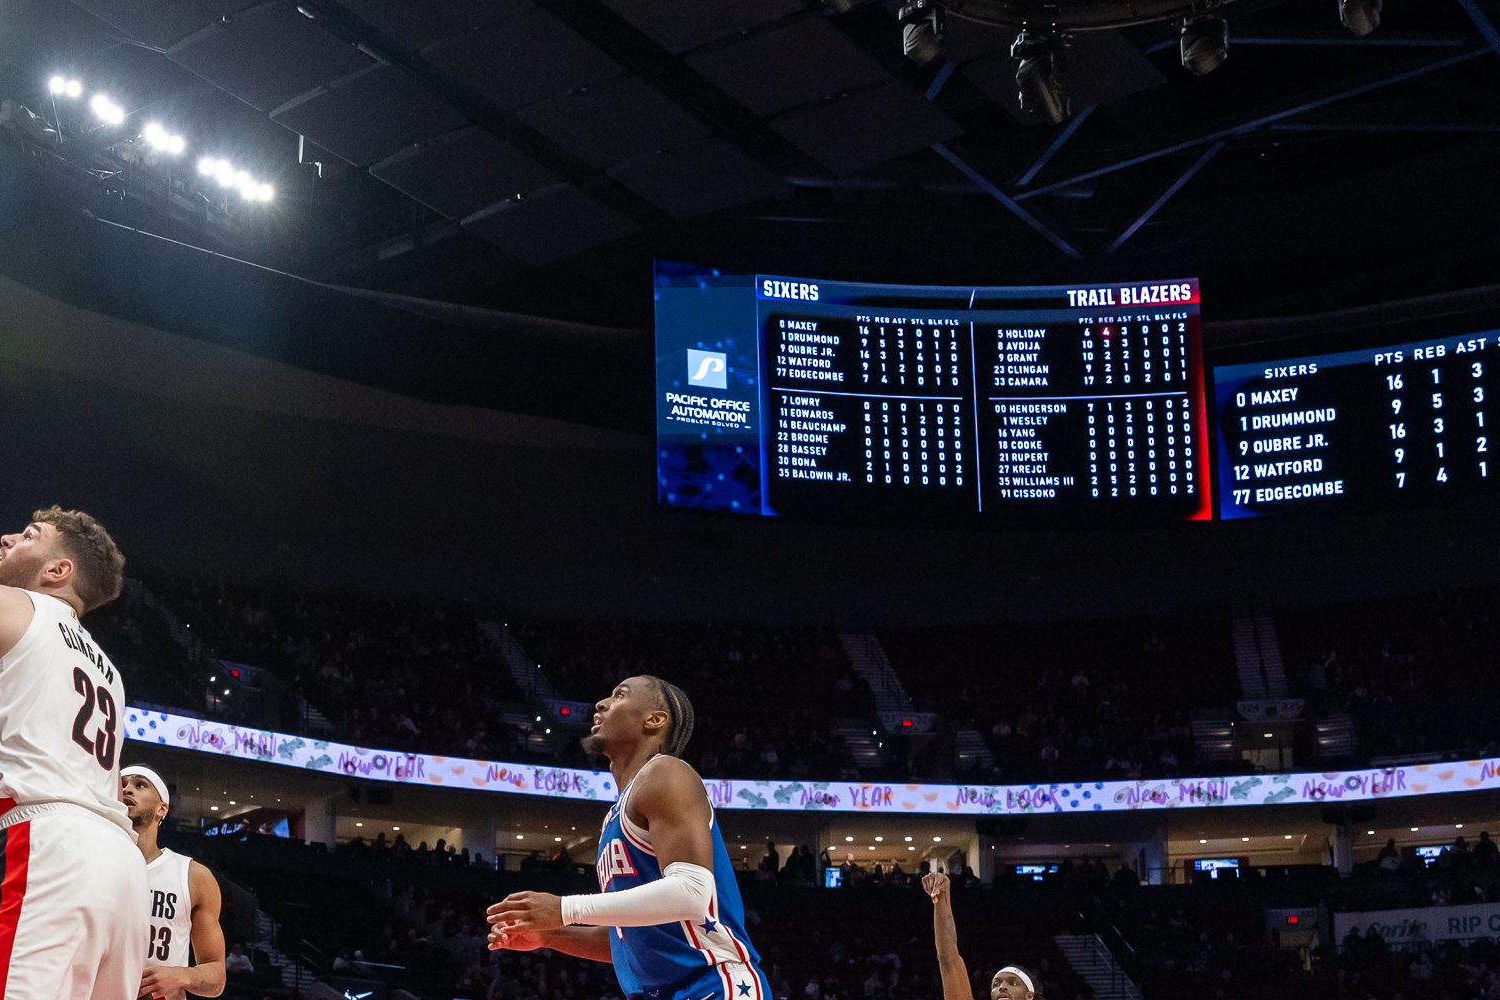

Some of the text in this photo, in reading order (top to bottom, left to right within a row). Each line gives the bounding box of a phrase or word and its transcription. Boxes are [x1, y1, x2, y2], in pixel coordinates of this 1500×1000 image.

[764, 280, 818, 300] SIXERS
[1067, 284, 1191, 306] TRAIL BLAZERS
[780, 320, 817, 331] 0 MAXEY
[782, 332, 839, 346] 1 DRUMMOND
[998, 330, 1045, 338] 5 HOLIDAY
[781, 344, 835, 356] 9 OUBRE JR.
[998, 342, 1040, 350] 8 AVDIJA
[778, 356, 830, 370] 12 WATFORD
[1007, 354, 1037, 362] GRANT
[1265, 338, 1486, 378] SIXERS PTS REB AST
[777, 368, 843, 381] 77 EDGECOMBE
[994, 365, 1048, 374] 23 CLINGAN
[1008, 378, 1047, 386] CAMARA
[1237, 363, 1482, 407] 0 MAXEY 16 1 3
[666, 393, 750, 413] PACIFIC OFFICE
[782, 396, 820, 406] 7 LOWRY
[671, 405, 747, 423] AUTOMATION
[781, 408, 833, 419] 11 EDWARDS
[995, 404, 1066, 413] 00 HENDERSON
[1241, 387, 1483, 431] 1 DRUMMOND 9 5 3
[676, 416, 740, 429] PROBLEM SOLVED
[780, 420, 846, 434] 16 BEAUCHAMP
[1004, 417, 1047, 425] 1 WESLEY
[778, 432, 828, 443] 22 BROOME
[999, 429, 1035, 437] 16 YANG
[1240, 412, 1483, 455] 9 OUBRE JR. 16 3 1
[778, 444, 826, 455] 28 BASSEY
[999, 441, 1041, 449] 18 COOKE
[779, 456, 816, 467] 30 BONA
[1000, 453, 1048, 461] 21 RUPERT
[1234, 437, 1486, 480] 12 WATFORD 9 1 2
[779, 468, 850, 481] 35 BALDWIN JR.
[999, 465, 1046, 473] 27 KREJCI
[999, 477, 1073, 485] 35 WILLIAMS III
[1233, 462, 1486, 504] 77 EDGECOMBE 7 4 1
[1002, 489, 1055, 497] 91 CISSOKO
[58, 622, 114, 687] CLINGAN
[72, 667, 117, 771] 23
[188, 724, 277, 758] New MENU
[337, 751, 426, 778] New YEAR
[486, 764, 583, 793] New LOOK
[1303, 768, 1407, 801] New YEAR
[800, 786, 894, 808] New YEAR
[956, 787, 1060, 809] New LOOK
[1127, 781, 1229, 806] New MENU
[1448, 916, 1482, 934] RIP
